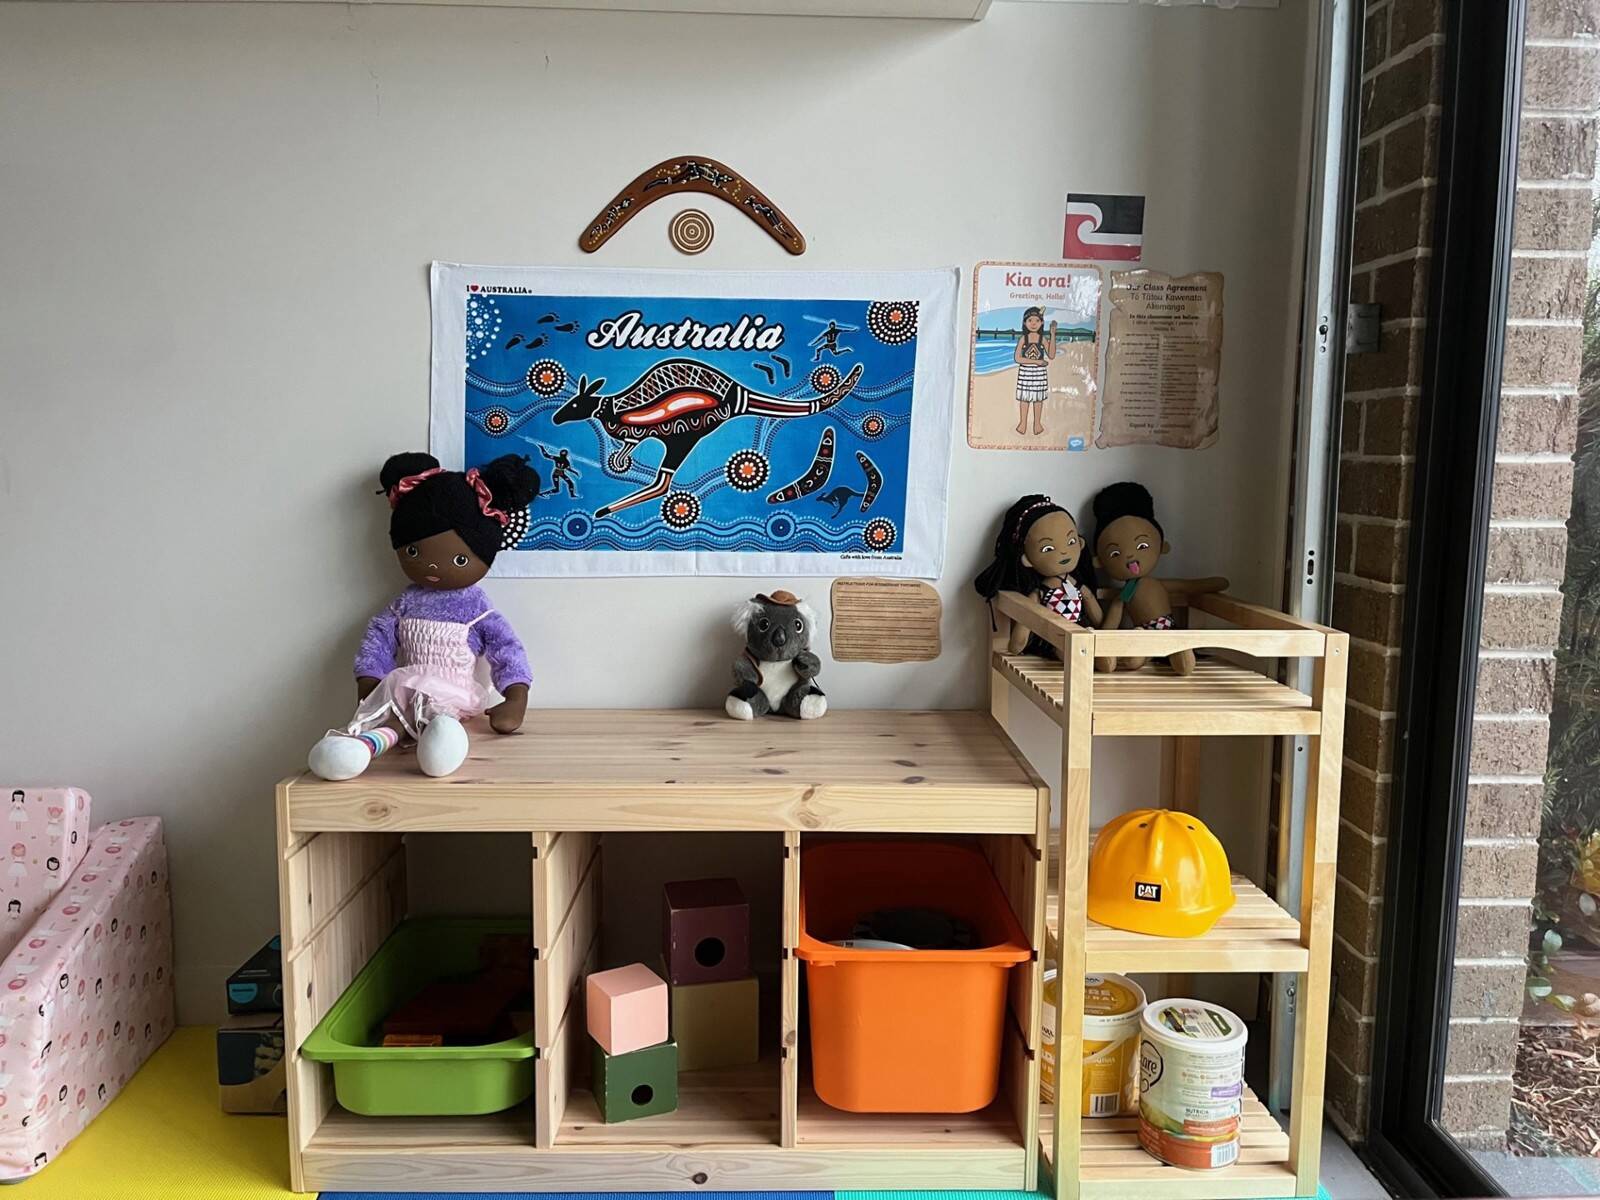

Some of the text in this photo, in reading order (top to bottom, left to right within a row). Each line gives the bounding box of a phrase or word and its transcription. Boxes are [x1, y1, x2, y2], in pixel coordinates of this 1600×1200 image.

[1005, 272, 1072, 288] Kia ora!
[1143, 283, 1164, 291] Class
[1166, 284, 1207, 293] Agreement
[586, 310, 785, 351] Australia
[1138, 884, 1158, 899] CAT
